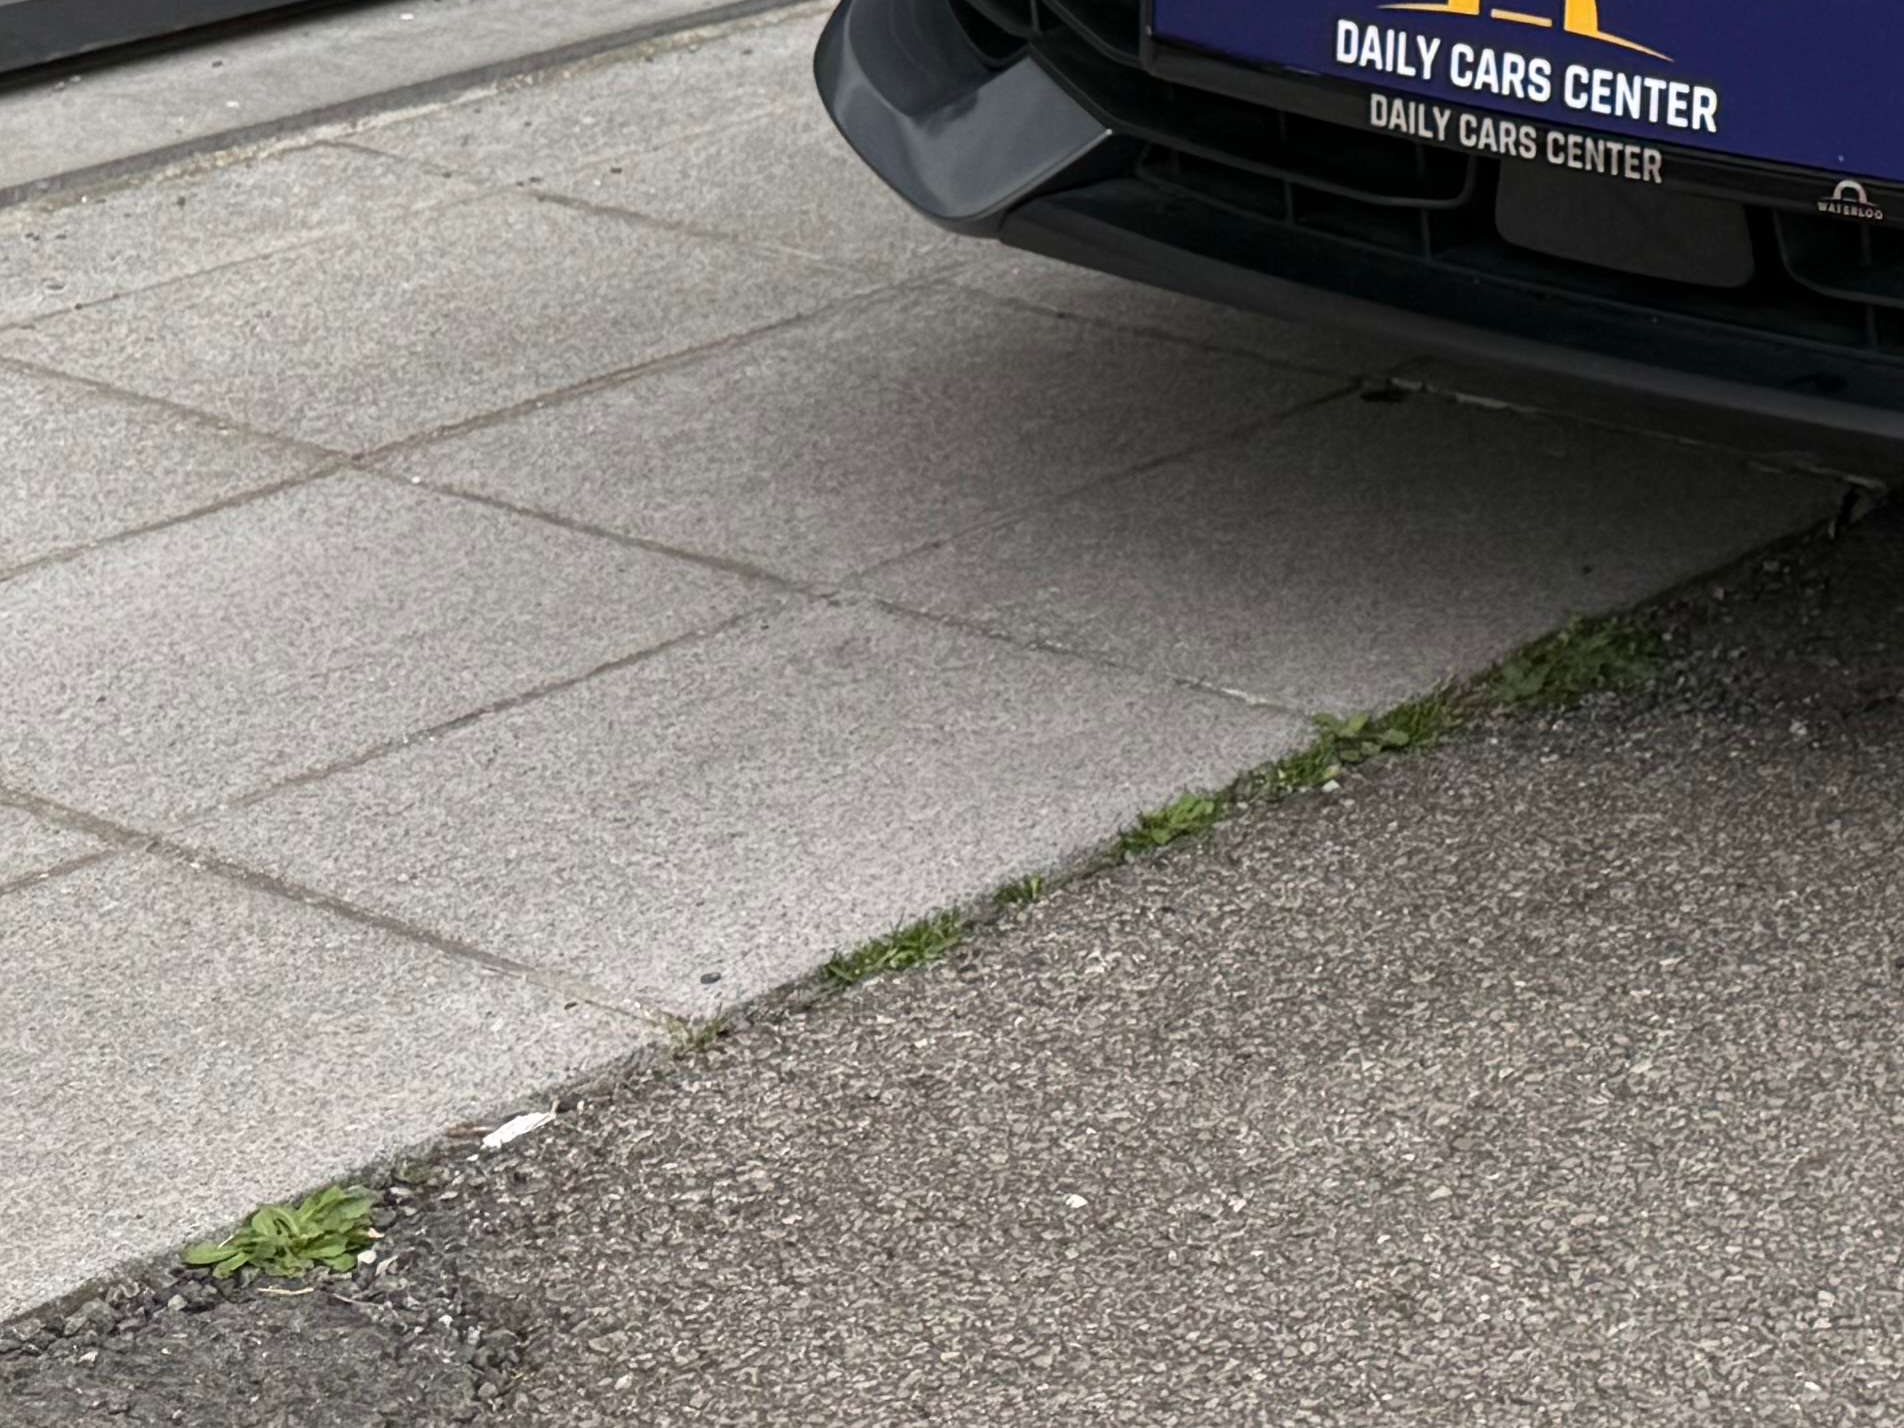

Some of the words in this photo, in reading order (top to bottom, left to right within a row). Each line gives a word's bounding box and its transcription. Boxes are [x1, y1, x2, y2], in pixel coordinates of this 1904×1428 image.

[1336, 19, 1441, 80] DAILY
[1450, 43, 1552, 103] CARS
[1564, 64, 1718, 133] CENTER
[1369, 93, 1451, 141] DAILY
[1459, 113, 1538, 160] CARS
[1546, 131, 1663, 184] CENTER
